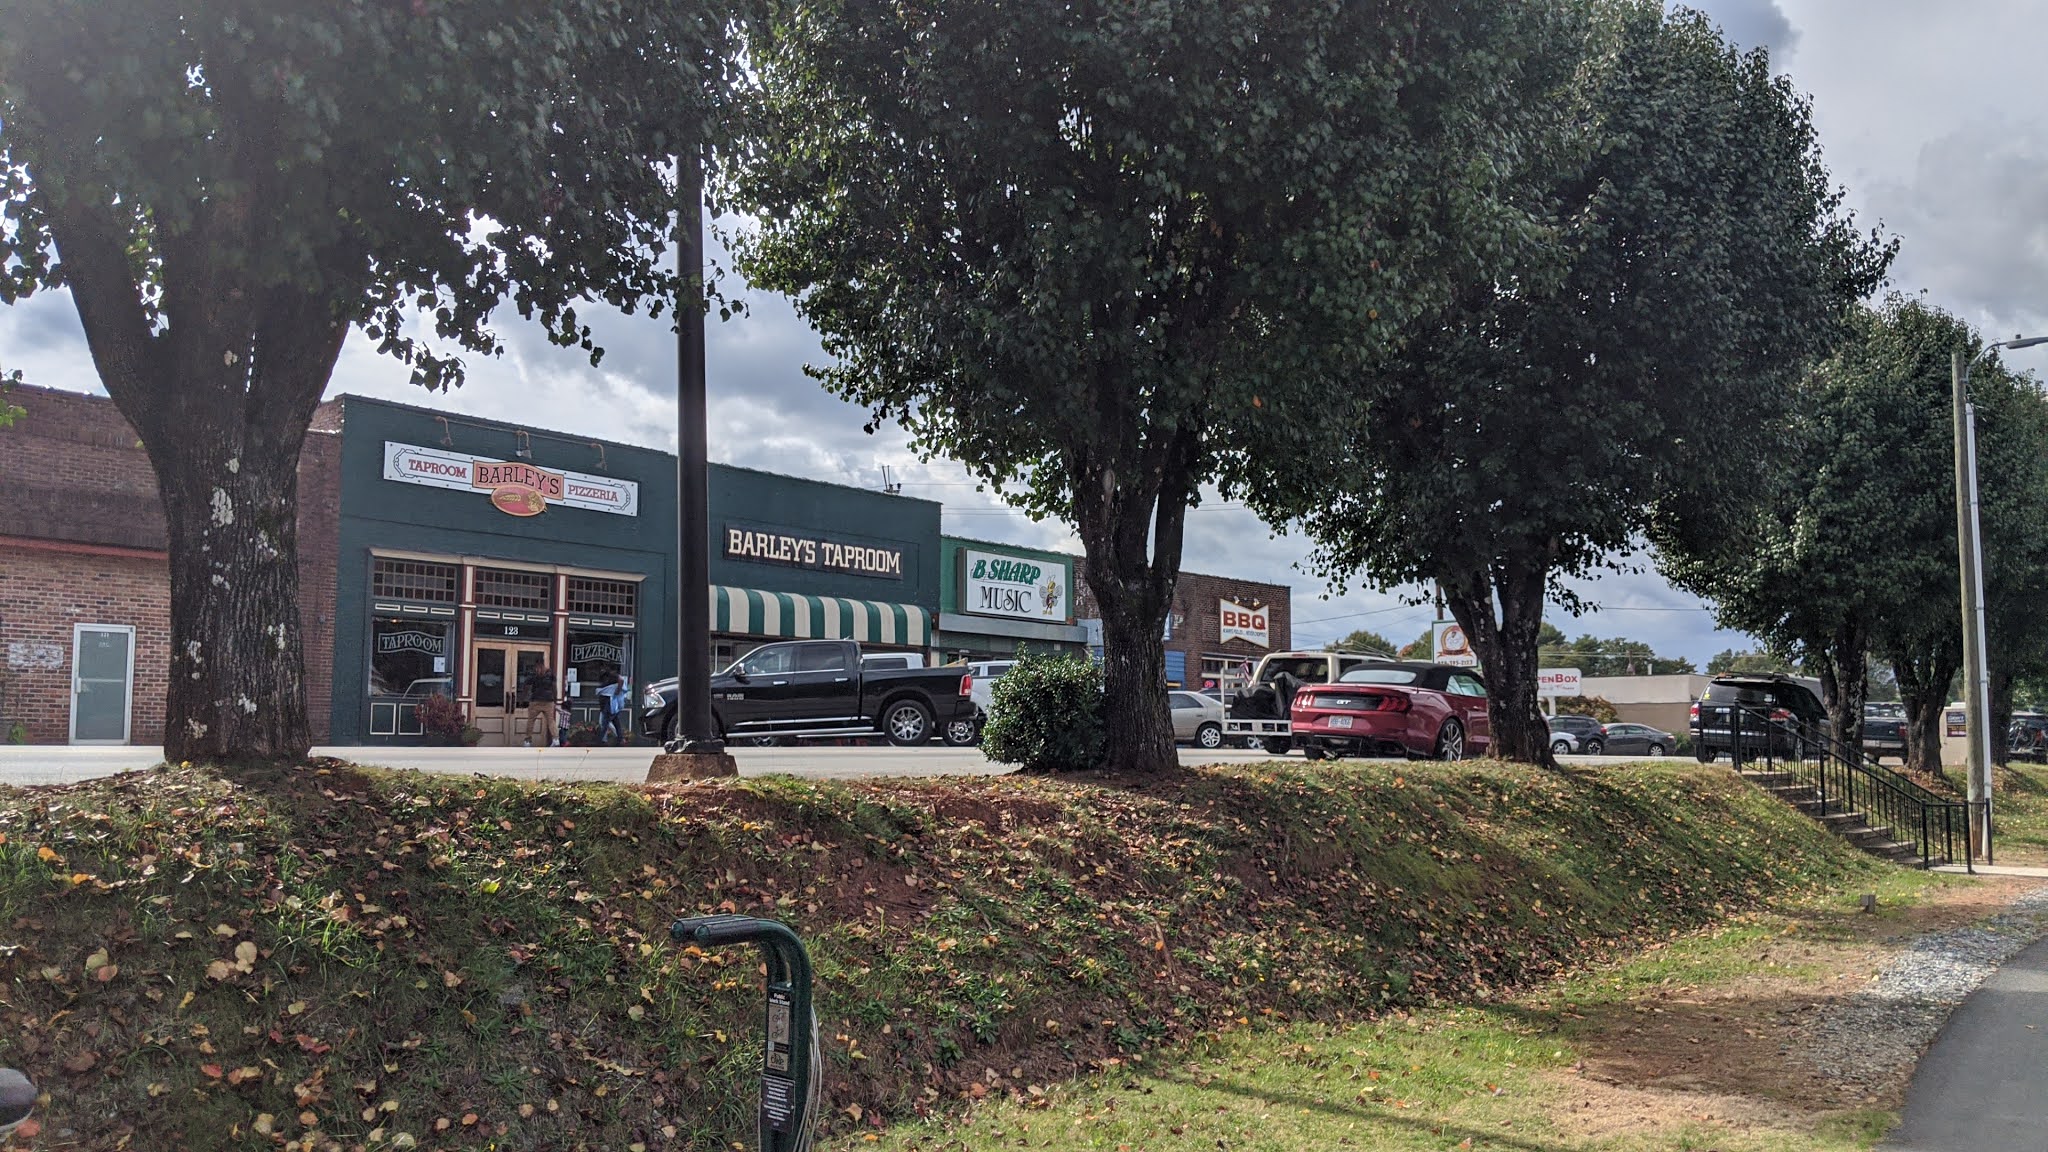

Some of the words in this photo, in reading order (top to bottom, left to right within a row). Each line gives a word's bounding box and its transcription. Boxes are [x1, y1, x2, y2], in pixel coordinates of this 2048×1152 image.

[408, 458, 467, 479] TAPROOM
[478, 466, 560, 495] BARLEY'S
[567, 484, 619, 503] PIZZERIA
[728, 528, 816, 564] BARLEY'S
[821, 542, 901, 574] TAPROOM
[972, 559, 987, 579] B
[988, 558, 1041, 585] SHARP
[979, 585, 1032, 613] MUSIC
[503, 626, 519, 636] 123
[1223, 610, 1266, 630] BBQ
[381, 632, 444, 653] TAPROOM
[574, 644, 623, 661] PIZZERIA
